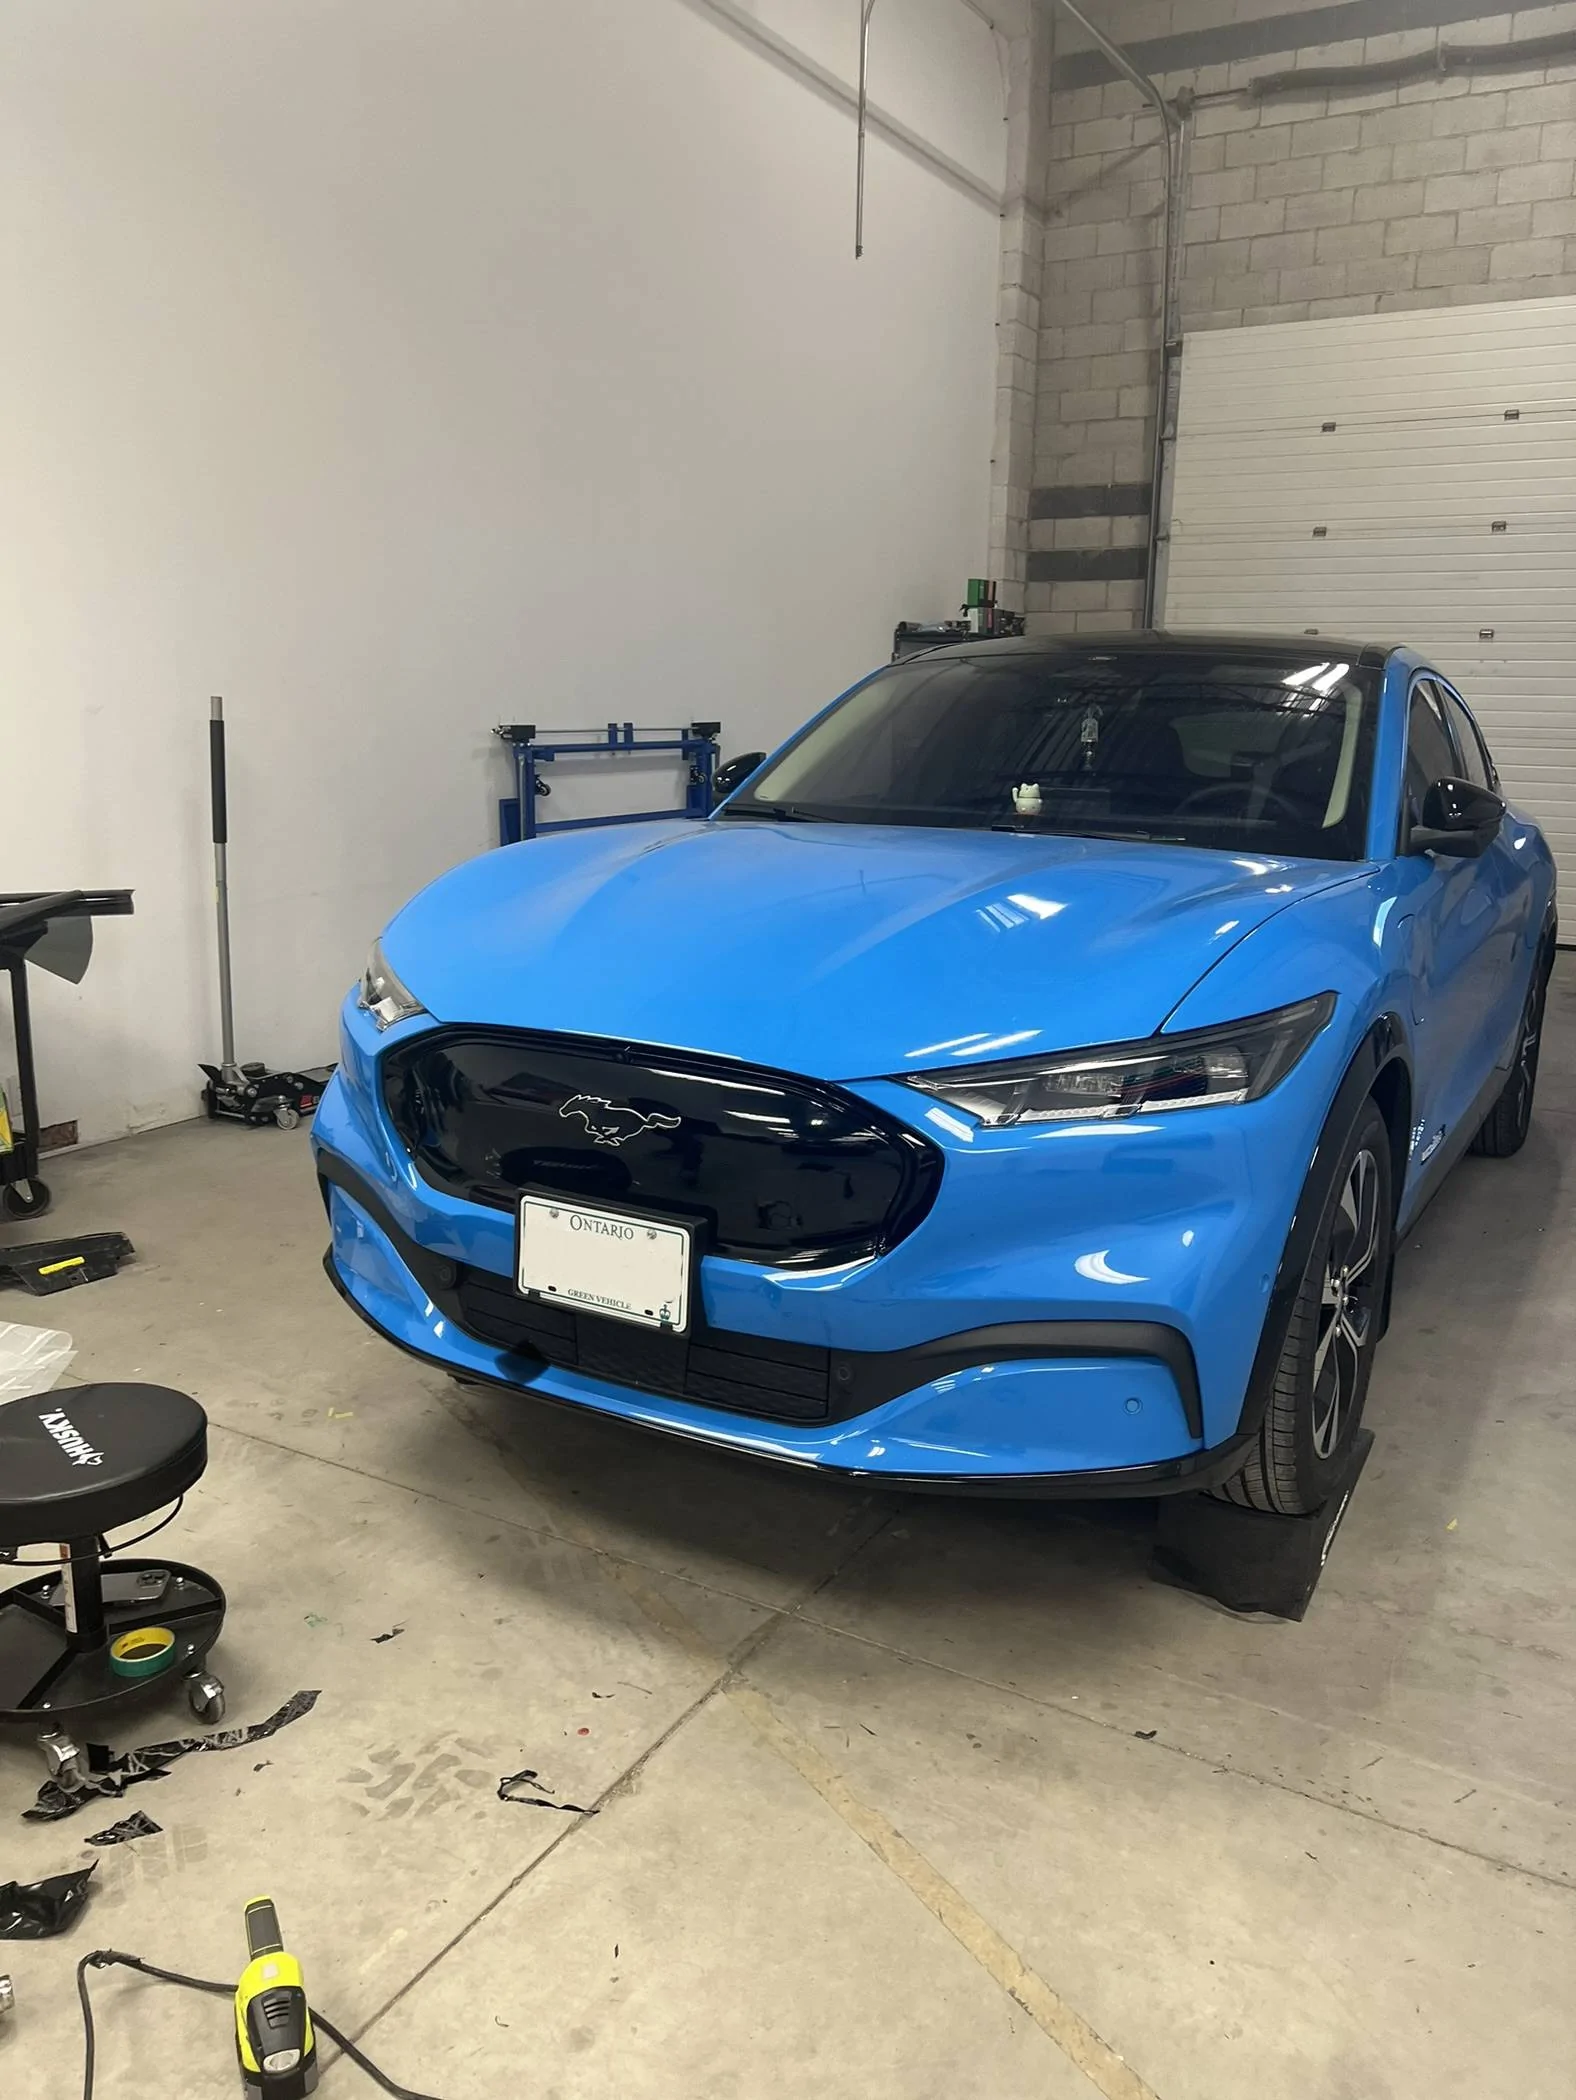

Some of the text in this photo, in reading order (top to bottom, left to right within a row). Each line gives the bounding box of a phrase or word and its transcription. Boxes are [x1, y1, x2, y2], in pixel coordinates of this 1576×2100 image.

[570, 1214, 634, 1240] ONTARIO
[567, 1288, 632, 1310] GREEN VEHICLE
[38, 1411, 95, 1458] HUSKY
